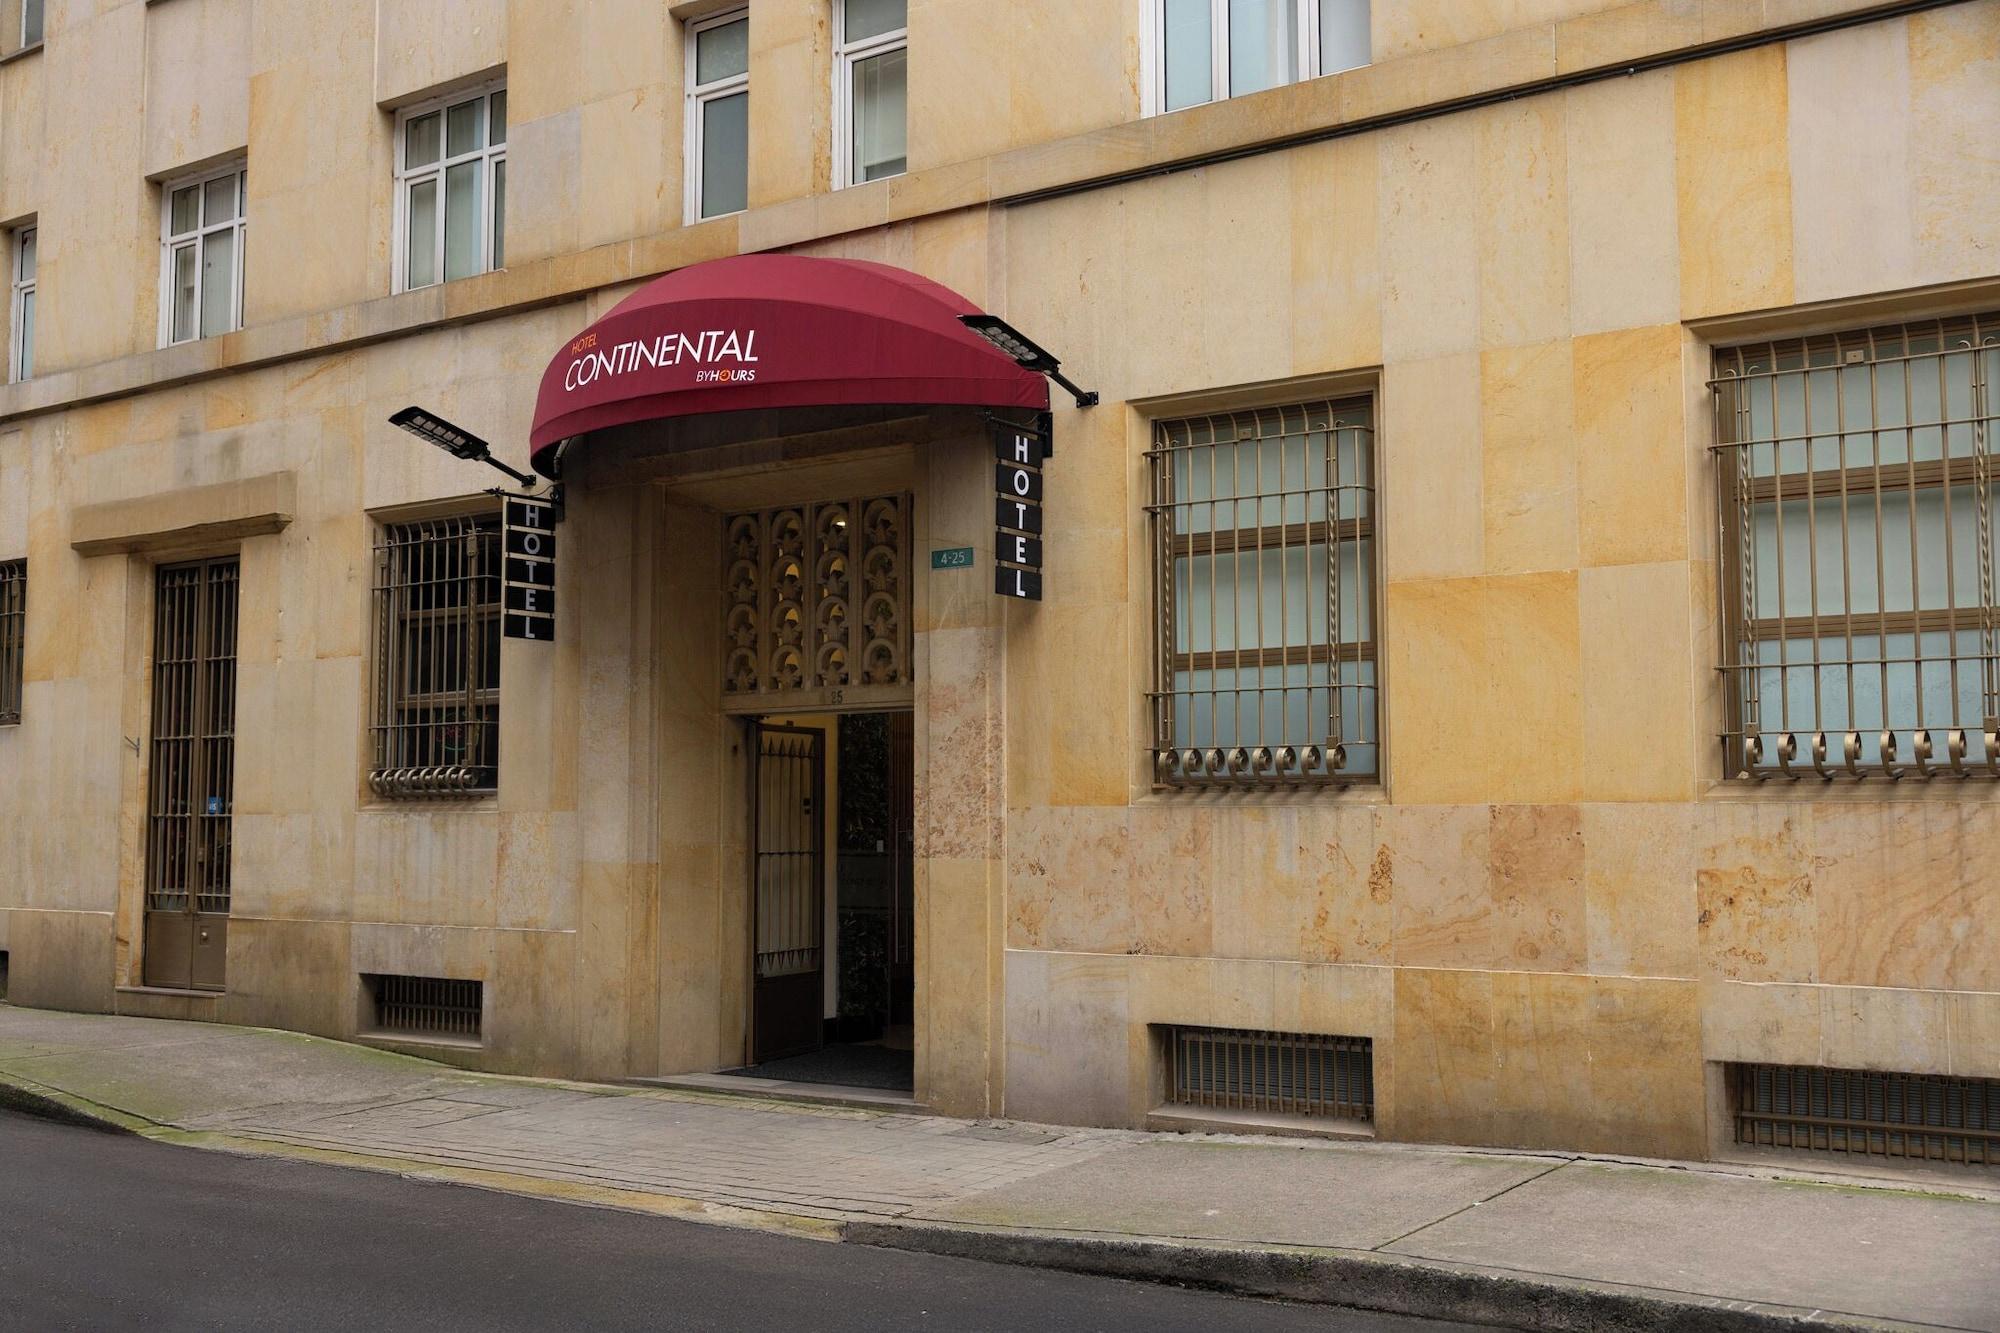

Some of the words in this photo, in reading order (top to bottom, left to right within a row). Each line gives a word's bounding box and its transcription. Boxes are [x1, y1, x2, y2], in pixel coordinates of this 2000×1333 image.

[565, 329, 759, 391] CONTINENTAL
[571, 333, 597, 355] HOTEL
[696, 368, 755, 384] BYHOURS
[1013, 435, 1030, 597] HOTEL
[523, 505, 541, 639] HOTEL
[940, 552, 965, 564] 4-25
